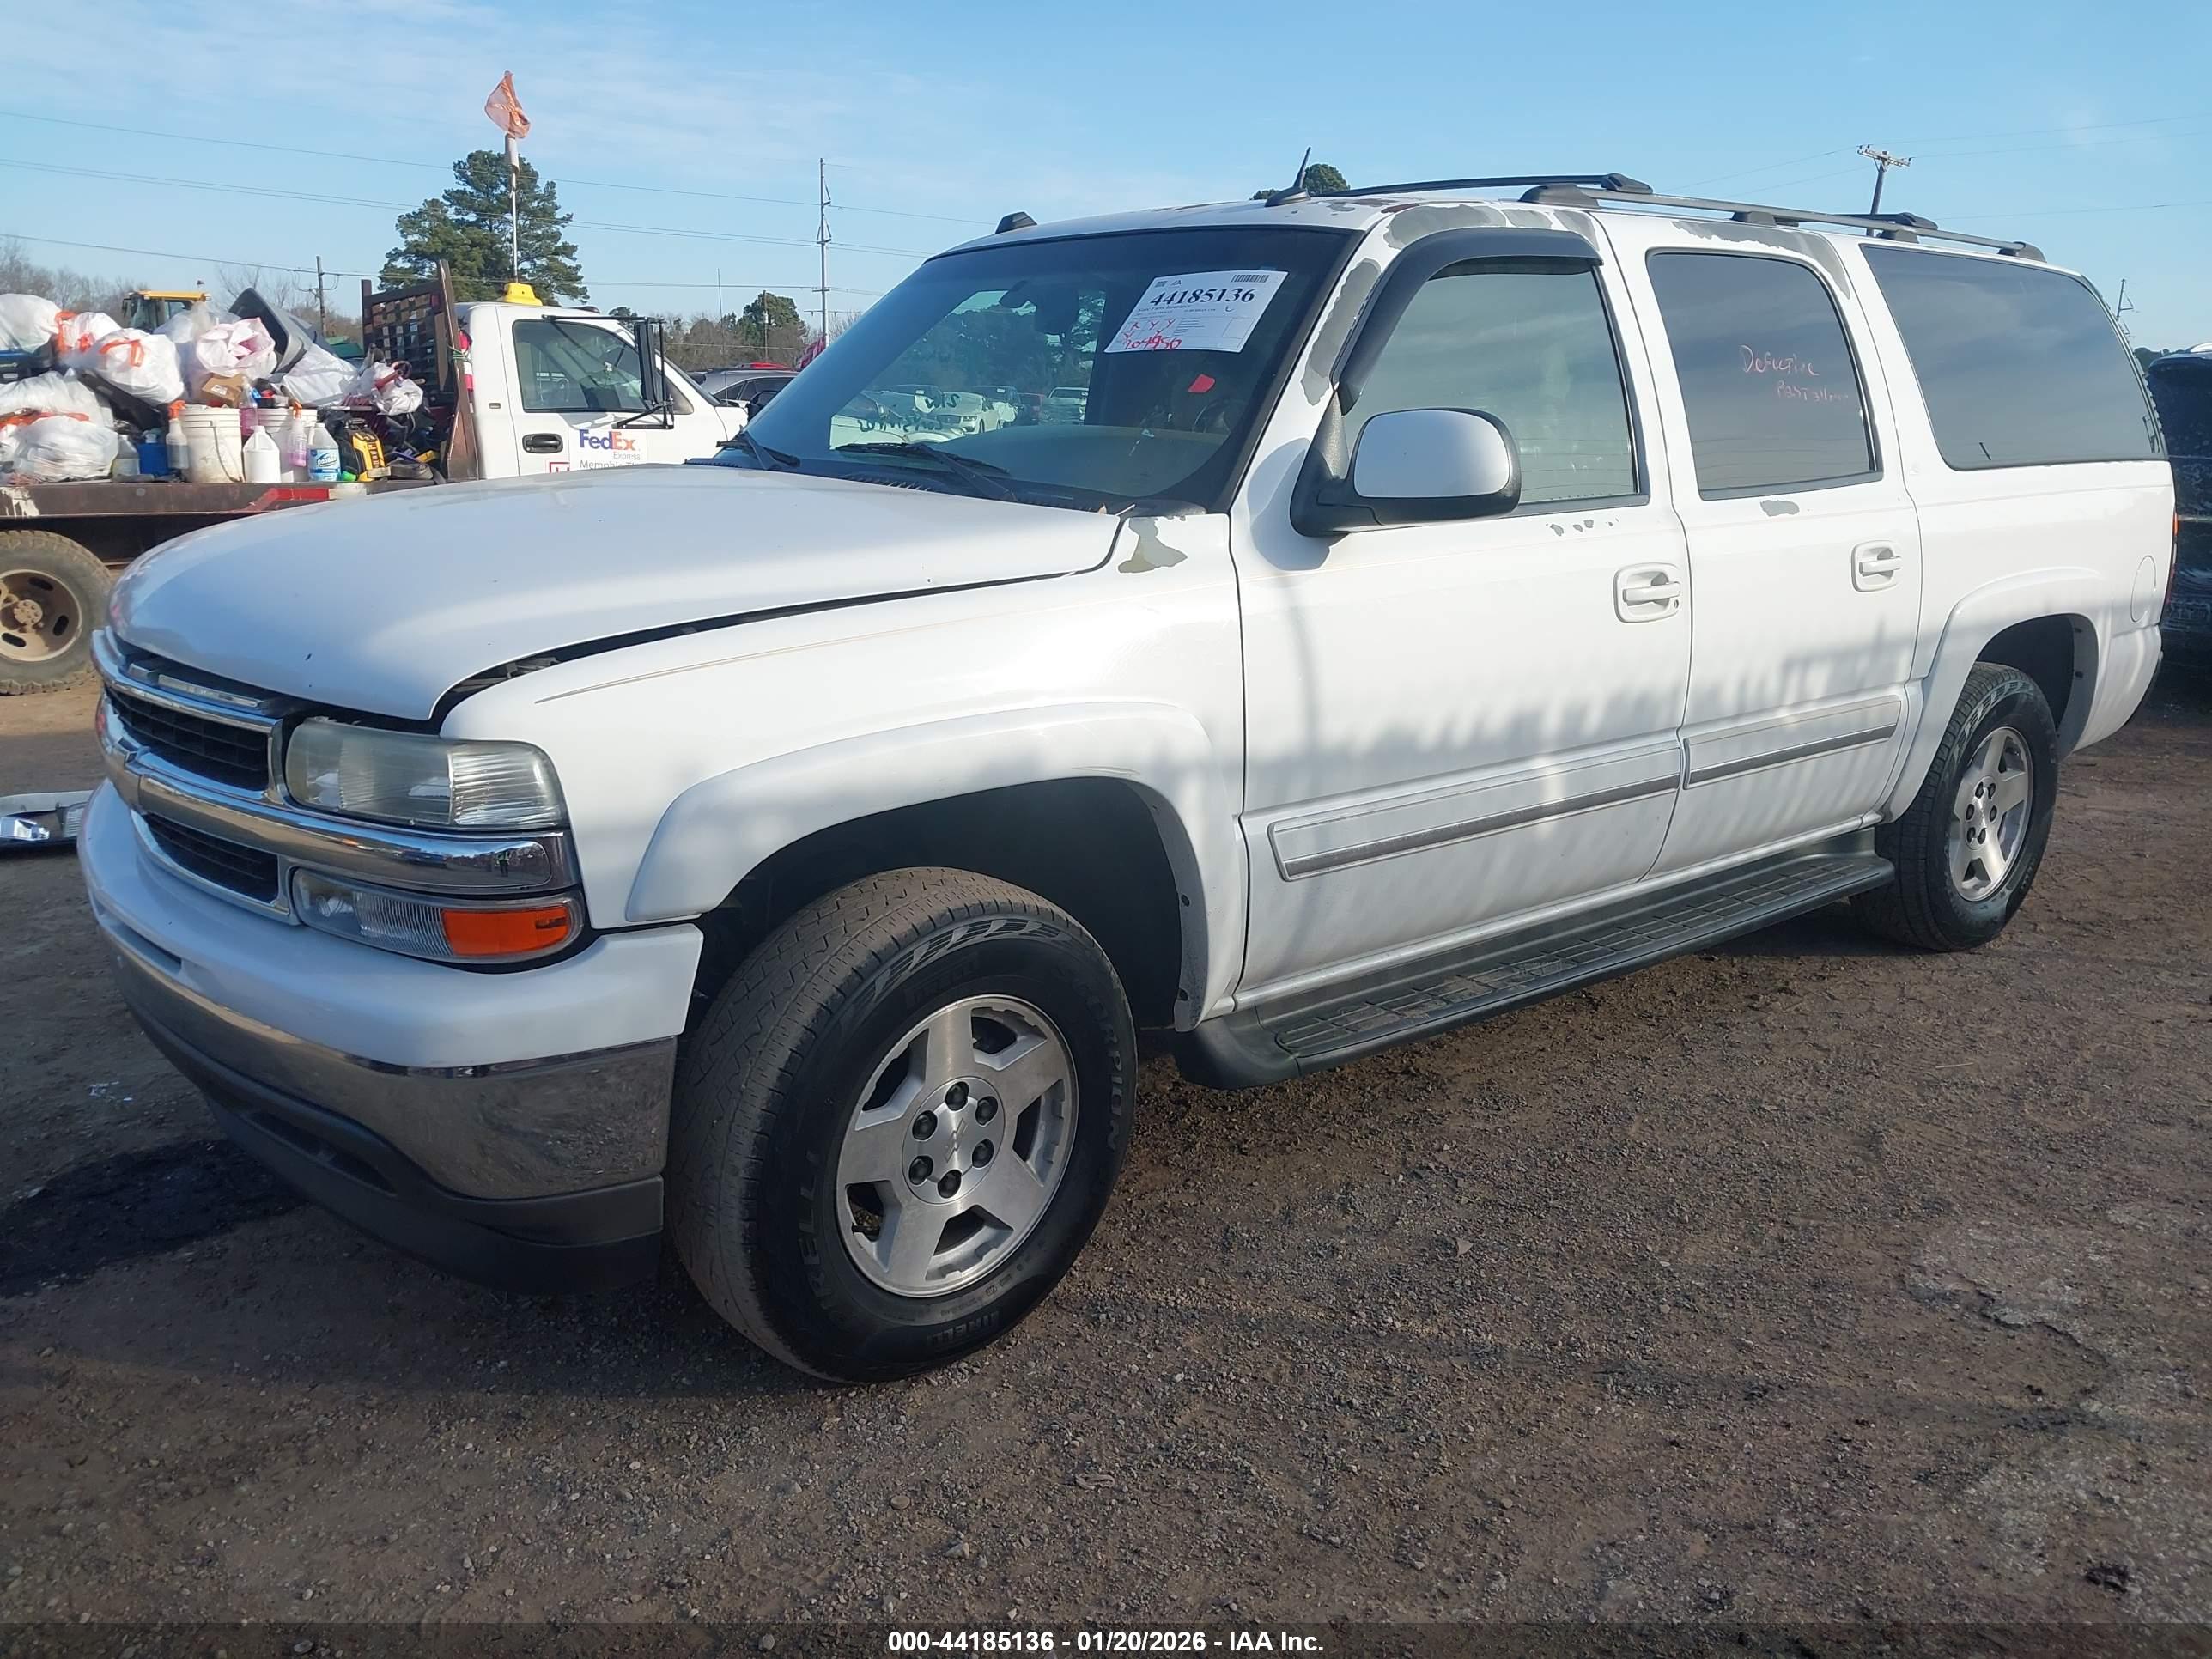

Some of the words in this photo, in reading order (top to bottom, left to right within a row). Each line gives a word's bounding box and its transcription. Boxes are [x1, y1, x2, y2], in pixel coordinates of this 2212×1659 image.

[1150, 287, 1260, 306] 44185136
[579, 428, 636, 450] FedEx
[613, 452, 641, 461] Express
[1052, 965, 1123, 1152] SCORPION
